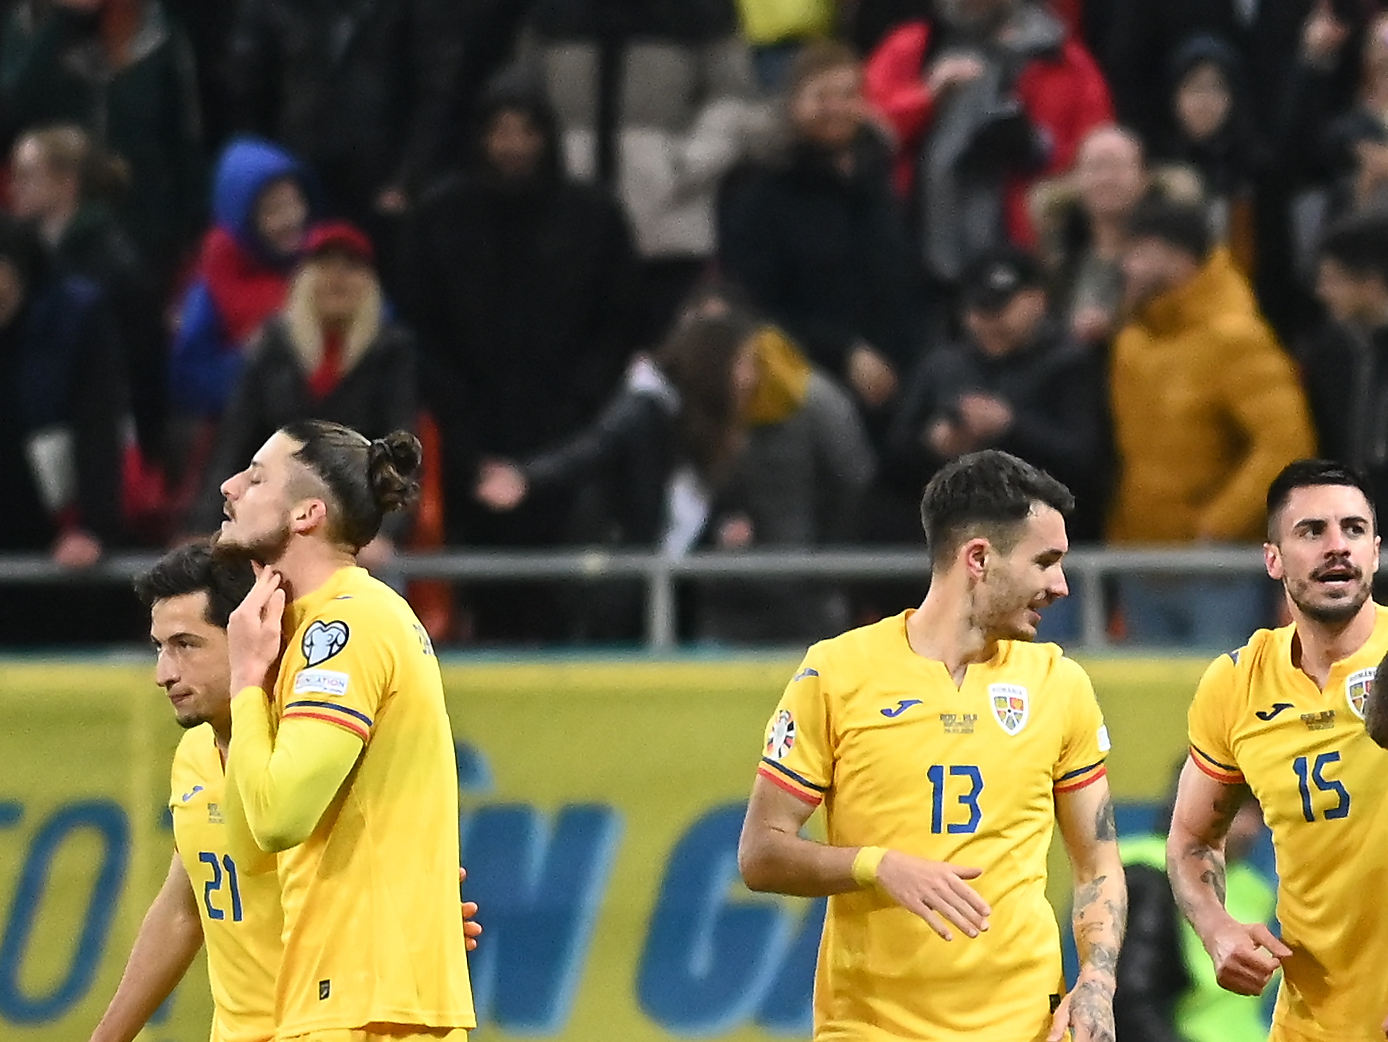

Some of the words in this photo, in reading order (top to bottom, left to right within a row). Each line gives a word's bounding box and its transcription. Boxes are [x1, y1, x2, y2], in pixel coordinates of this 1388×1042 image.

[927, 764, 985, 834] 13
[1292, 751, 1352, 823] 15
[198, 851, 243, 922] 21
